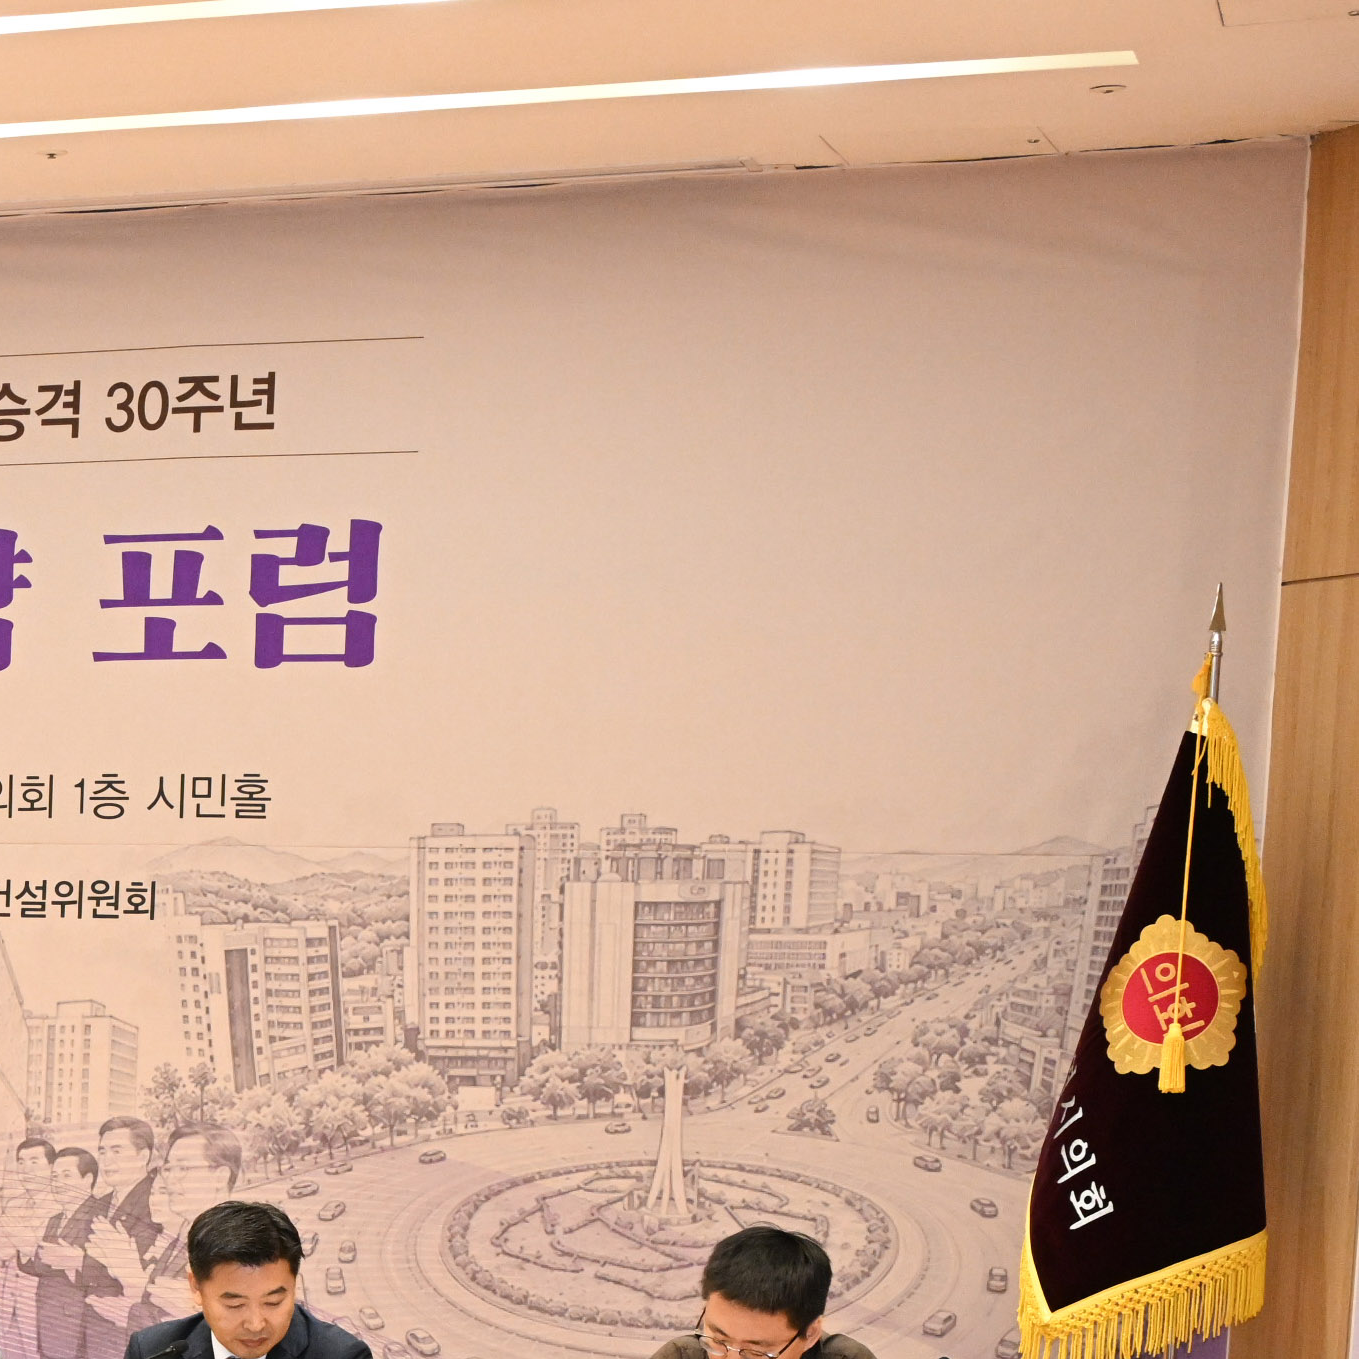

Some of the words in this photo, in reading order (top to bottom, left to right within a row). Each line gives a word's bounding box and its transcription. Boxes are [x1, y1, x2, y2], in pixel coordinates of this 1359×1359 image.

[104, 371, 278, 432] 30주년
[91, 518, 384, 670] 포럼
[73, 773, 130, 820] 1층
[146, 772, 273, 821] 시민홀
[1053, 1062, 1114, 1230] 시의회
